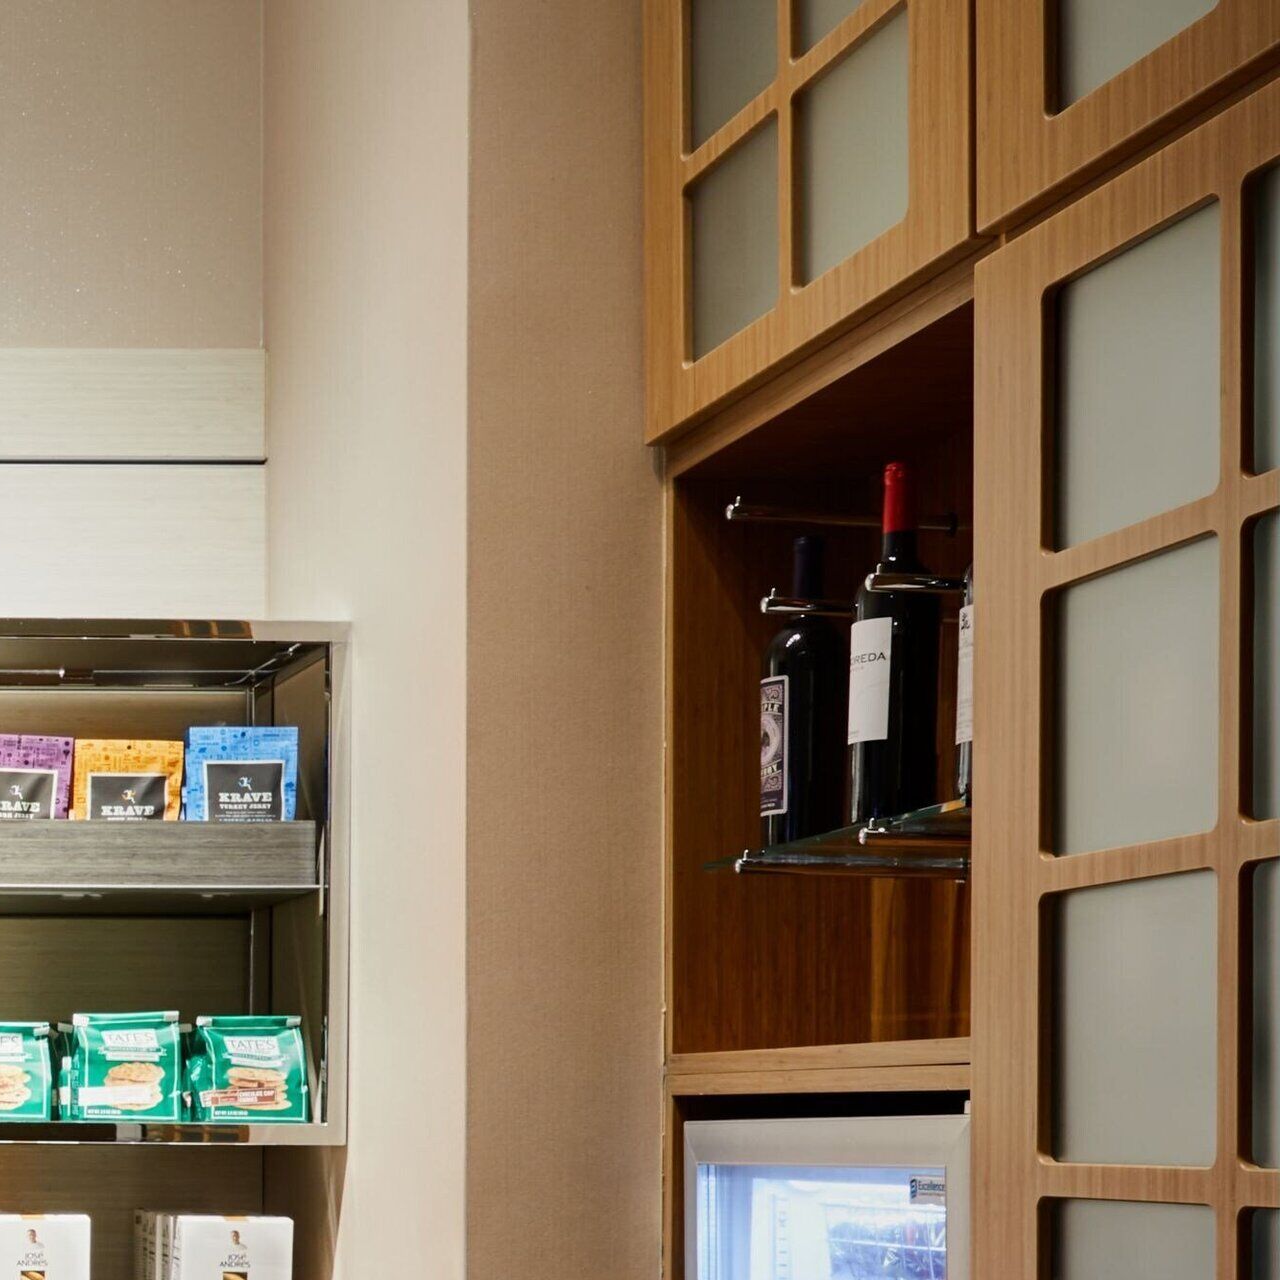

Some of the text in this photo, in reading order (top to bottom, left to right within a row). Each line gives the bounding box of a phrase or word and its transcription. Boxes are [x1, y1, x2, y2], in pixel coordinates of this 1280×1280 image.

[218, 792, 272, 802] KRAVE
[101, 805, 155, 816] KRAVE
[107, 1031, 154, 1044] TATE'S
[228, 1037, 277, 1051] TATE'S
